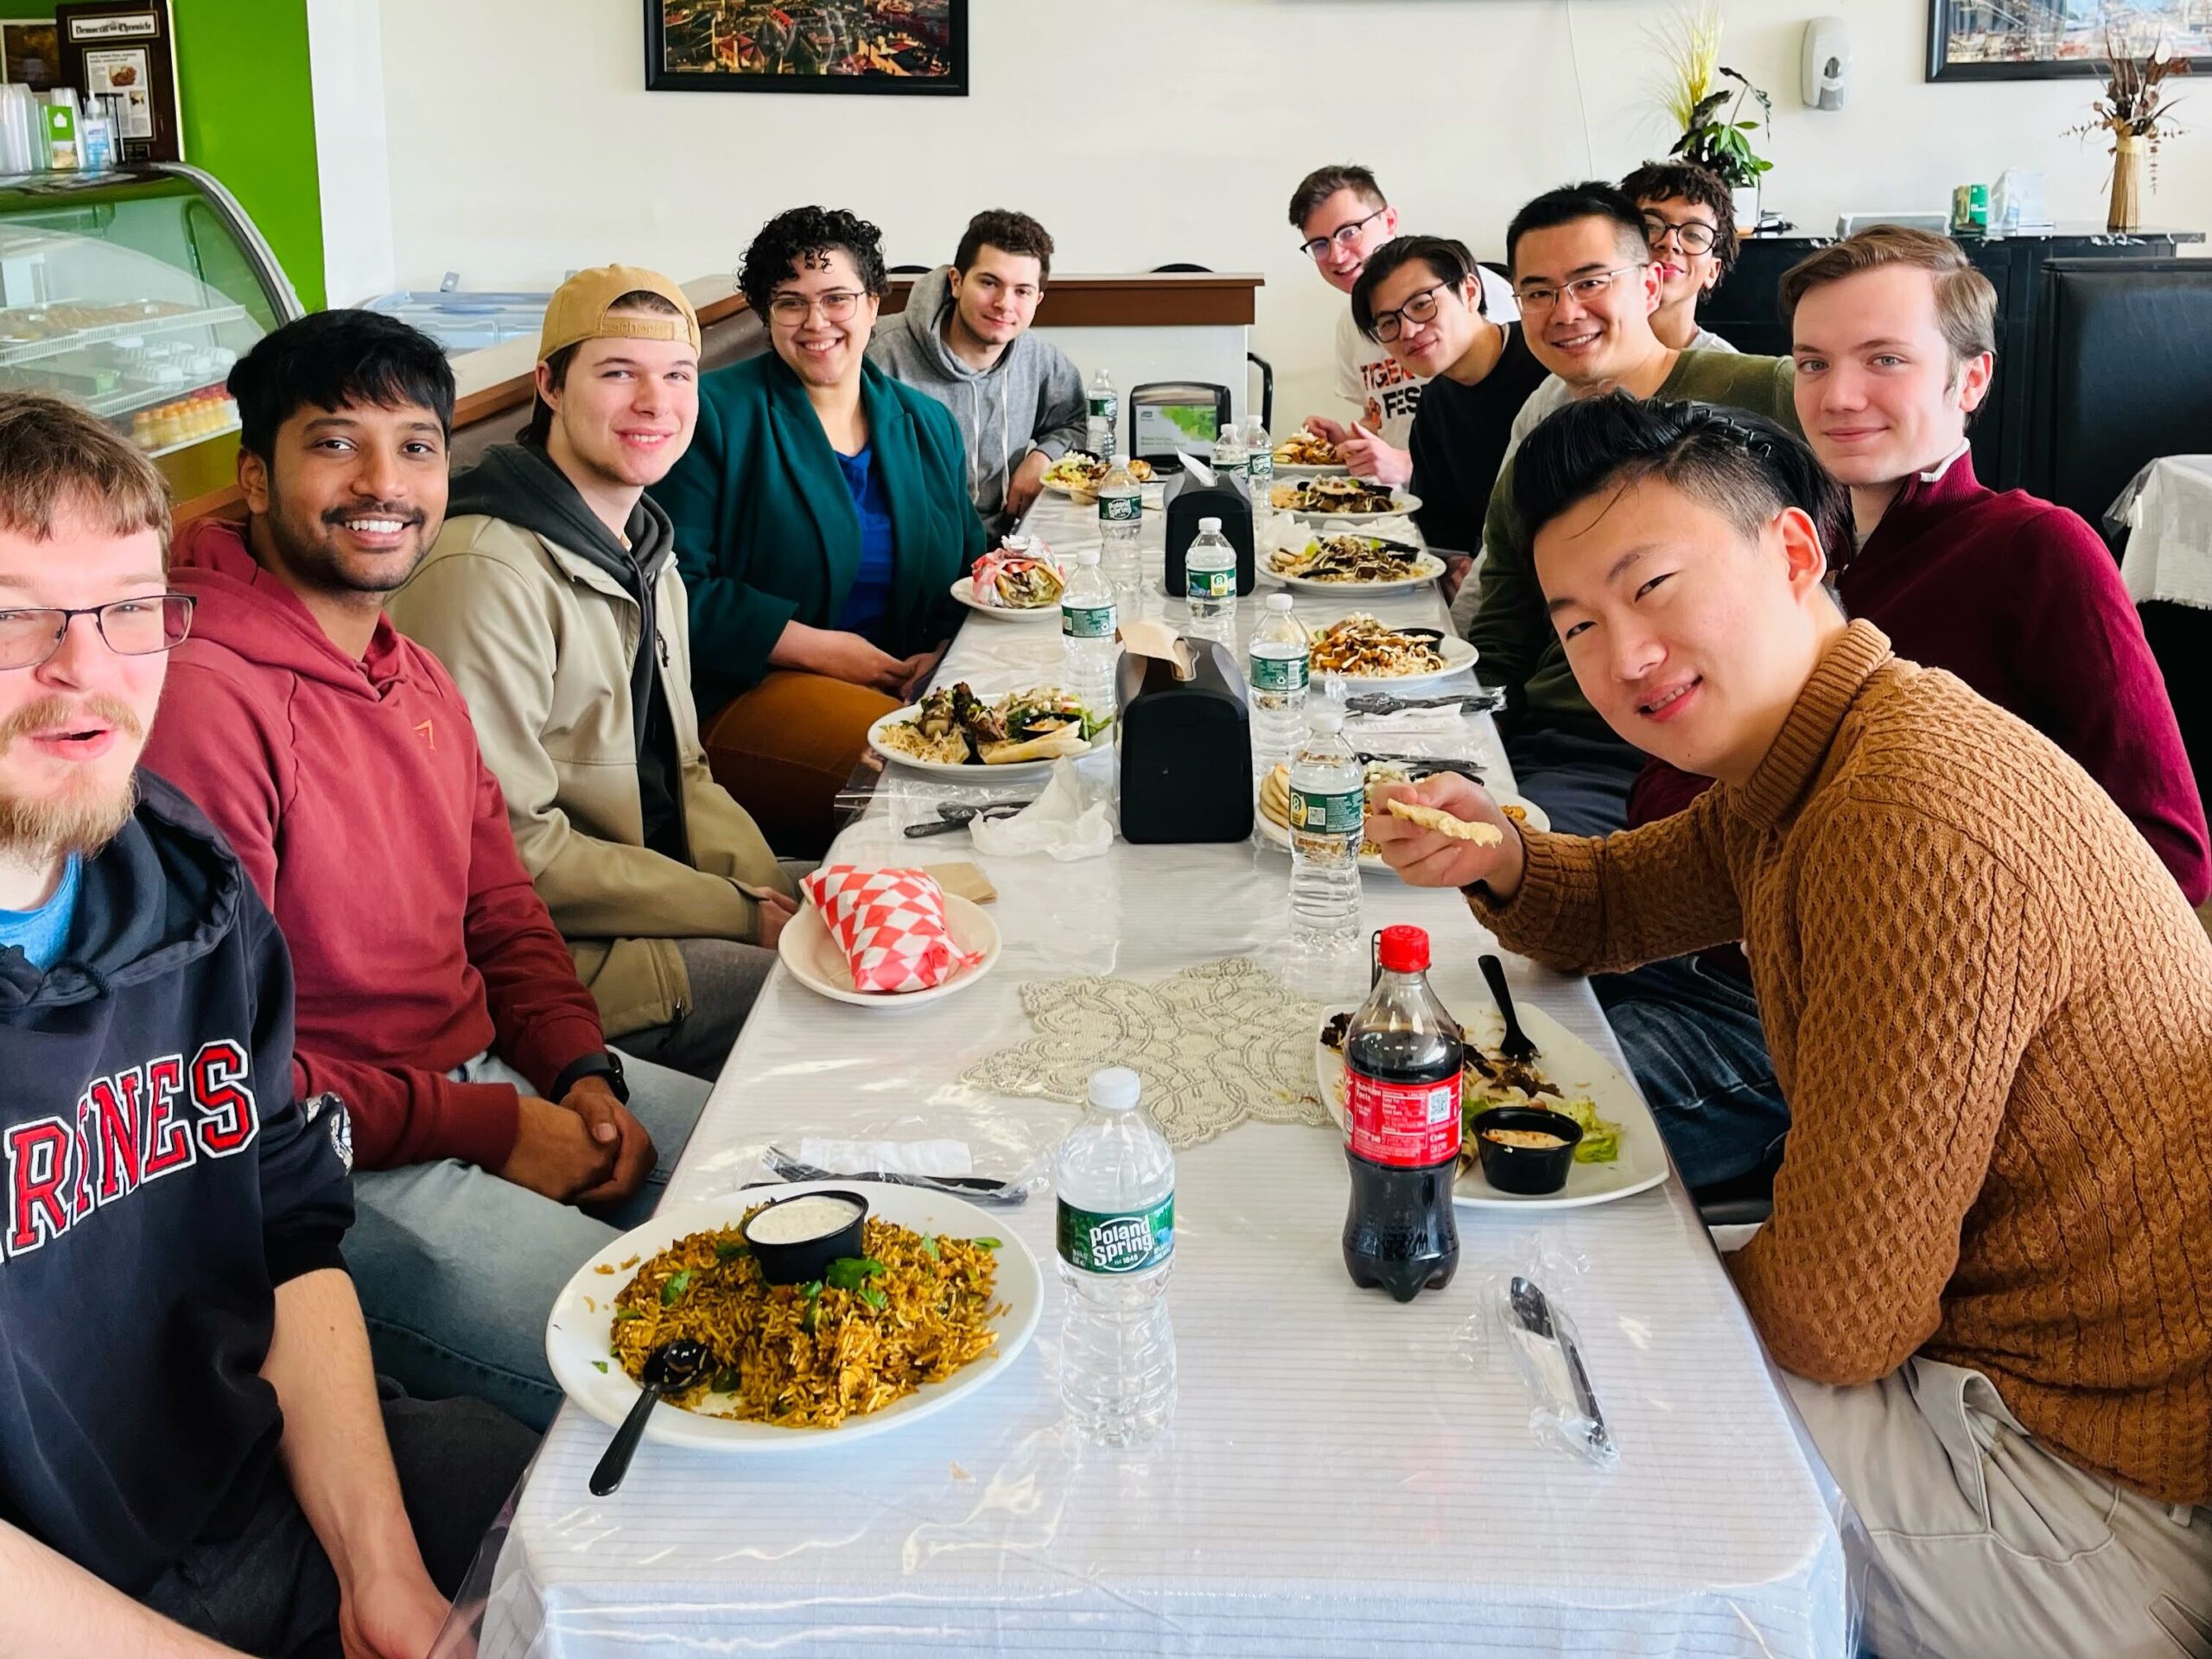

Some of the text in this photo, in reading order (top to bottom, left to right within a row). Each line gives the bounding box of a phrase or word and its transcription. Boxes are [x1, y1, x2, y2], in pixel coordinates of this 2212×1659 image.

[75, 24, 109, 35] Democrat
[118, 22, 151, 33] Chronicle
[0, 1039, 260, 1263] RINES
[1089, 1214, 1151, 1248] Poland
[1092, 1234, 1154, 1267] Spring
